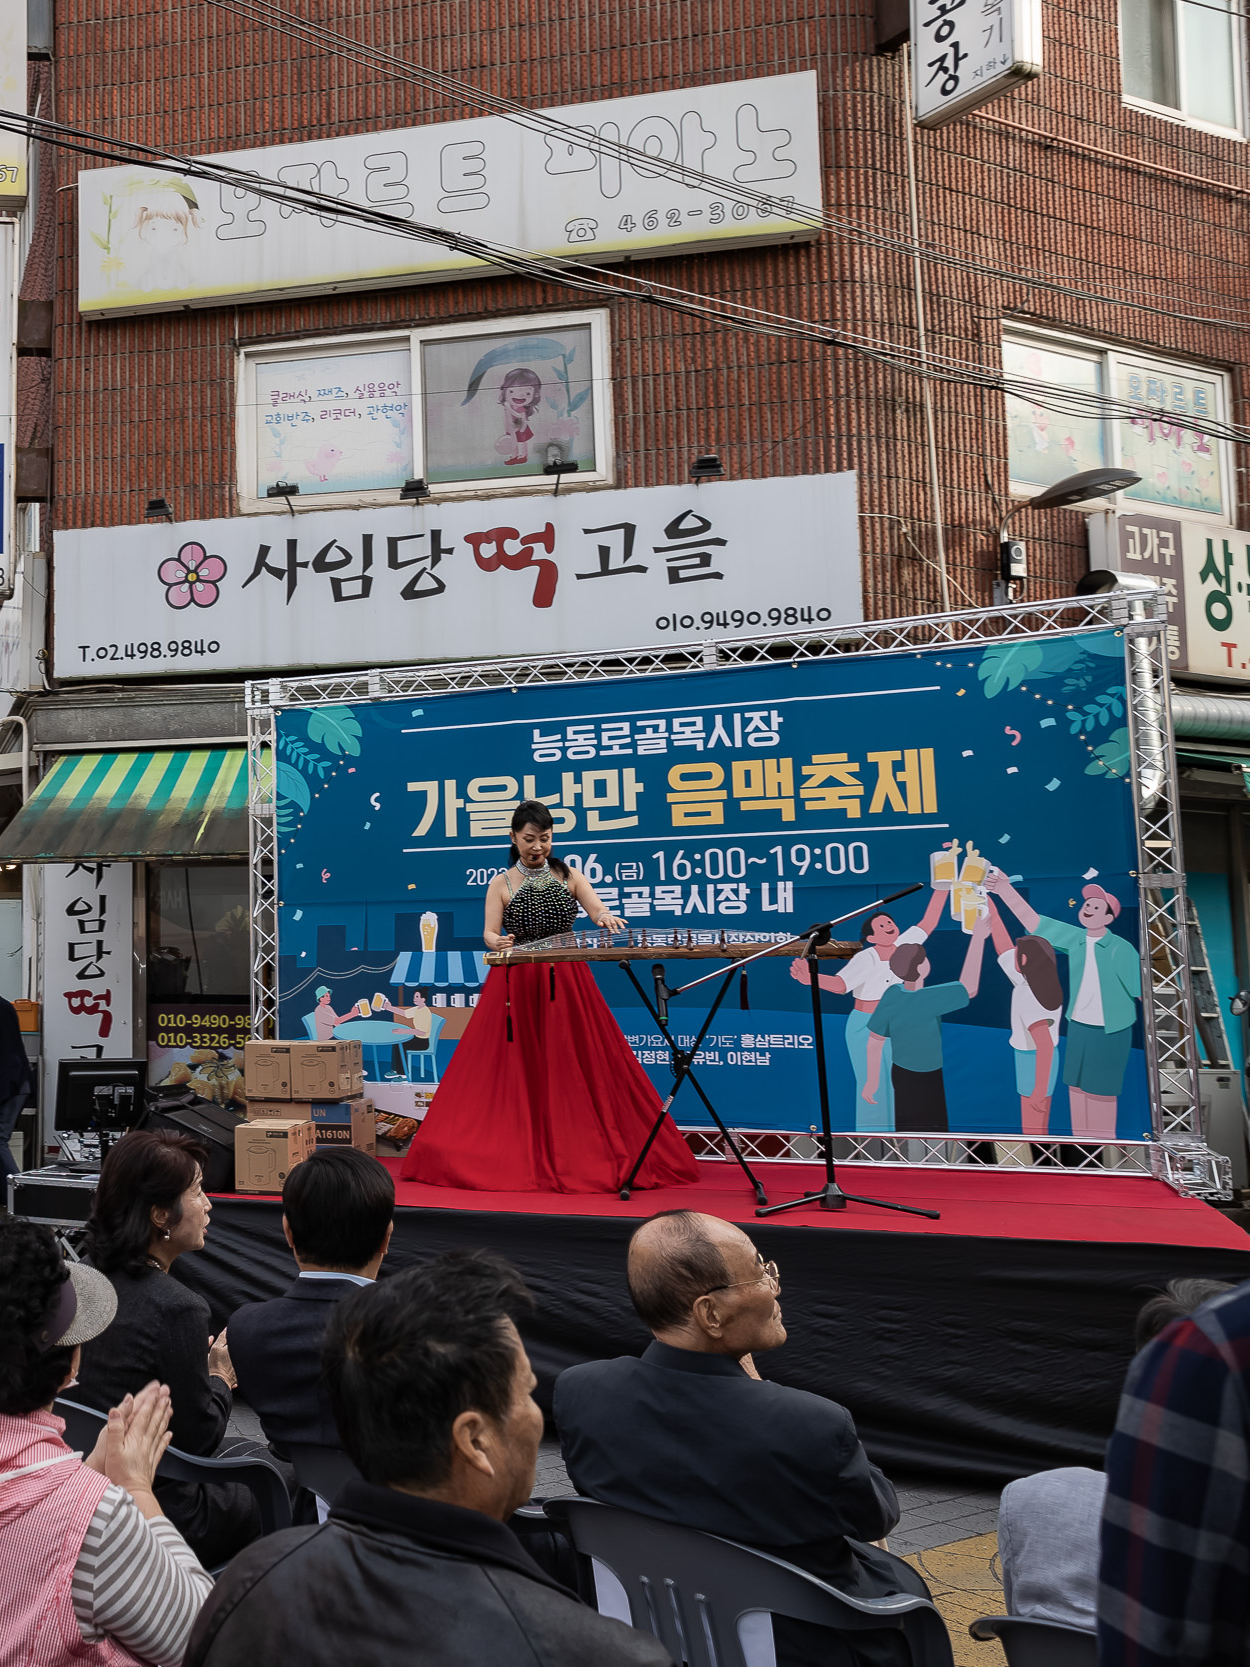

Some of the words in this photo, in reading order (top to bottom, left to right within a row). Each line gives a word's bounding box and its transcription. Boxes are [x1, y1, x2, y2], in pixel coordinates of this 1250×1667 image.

[543, 103, 797, 199] 피아노
[617, 195, 796, 233] 462-3067
[353, 380, 402, 400] 실용음악
[264, 411, 316, 428] 교회반주,
[319, 408, 363, 421] 리코더,
[366, 402, 409, 421] 관현악
[1125, 524, 1177, 566] 고가구
[655, 604, 832, 633] 010.9490.9840
[78, 638, 221, 664] T.02.498.9840
[1220, 641, 1250, 670] T.
[531, 710, 784, 763] 능동로골목시장
[406, 767, 645, 838] 가을낭만
[666, 747, 939, 828] 음맥축제
[651, 841, 870, 882] 16:00~19:00
[761, 880, 794, 913] 내
[157, 1013, 252, 1029] 010-9490-98
[740, 1033, 814, 1050] 홍삼트리오
[727, 1051, 772, 1066] 이현남
